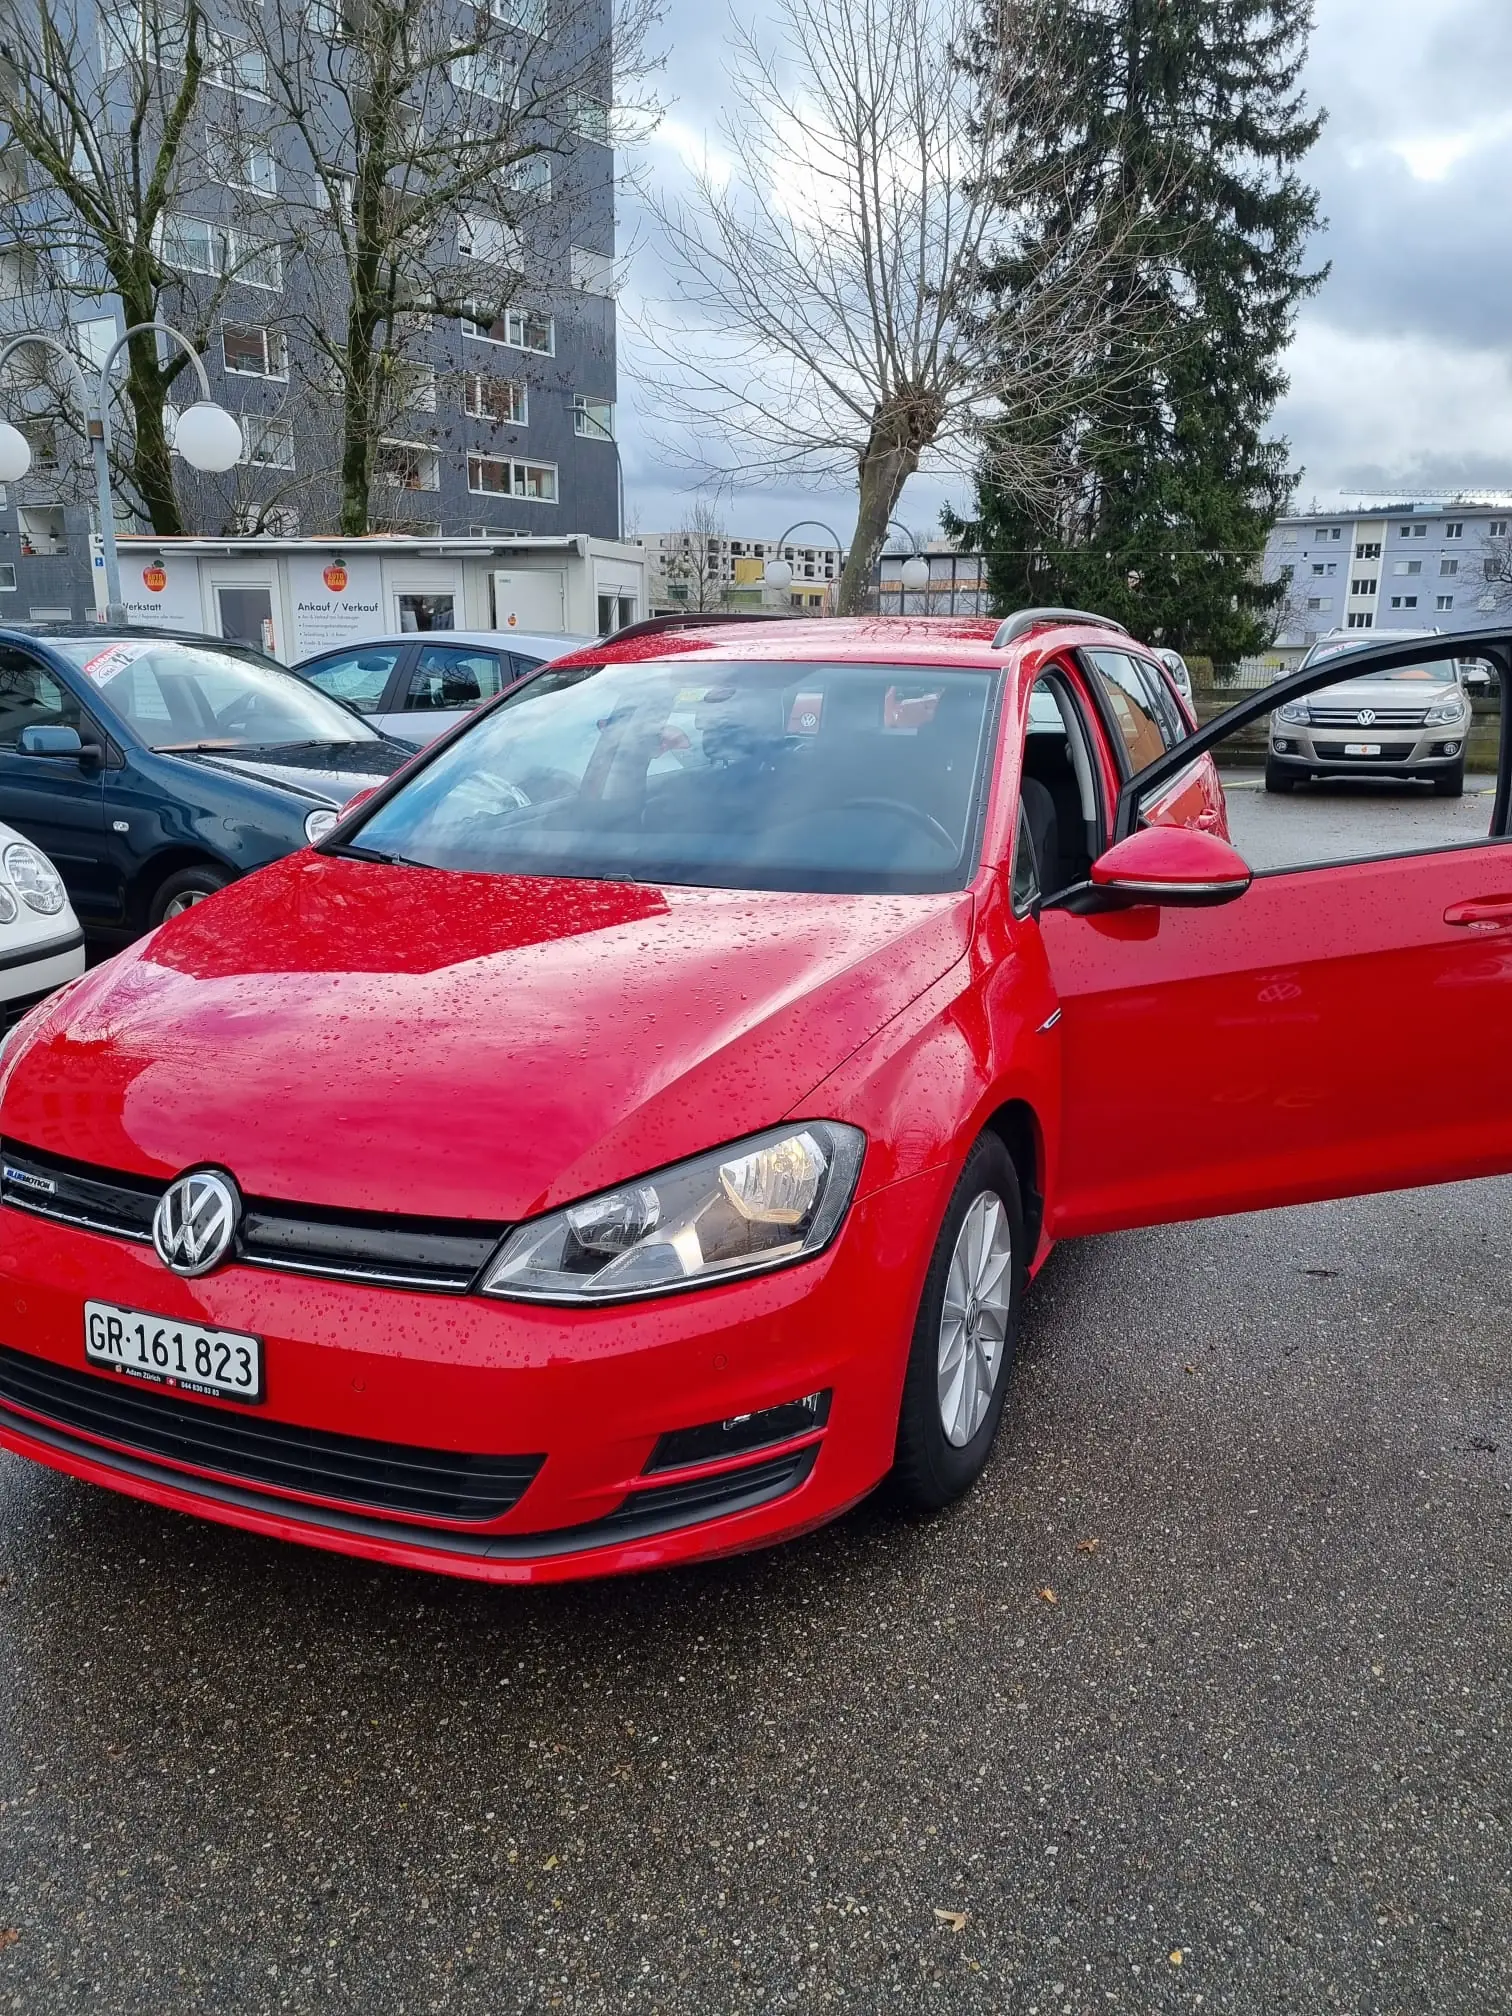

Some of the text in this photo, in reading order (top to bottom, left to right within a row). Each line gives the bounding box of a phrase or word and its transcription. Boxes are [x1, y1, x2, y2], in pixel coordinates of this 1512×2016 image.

[327, 572, 345, 580] AUTO
[297, 602, 380, 613] Ankauf / Verkauf
[125, 1368, 143, 1379] Adam
[142, 1370, 162, 1383] Zürich
